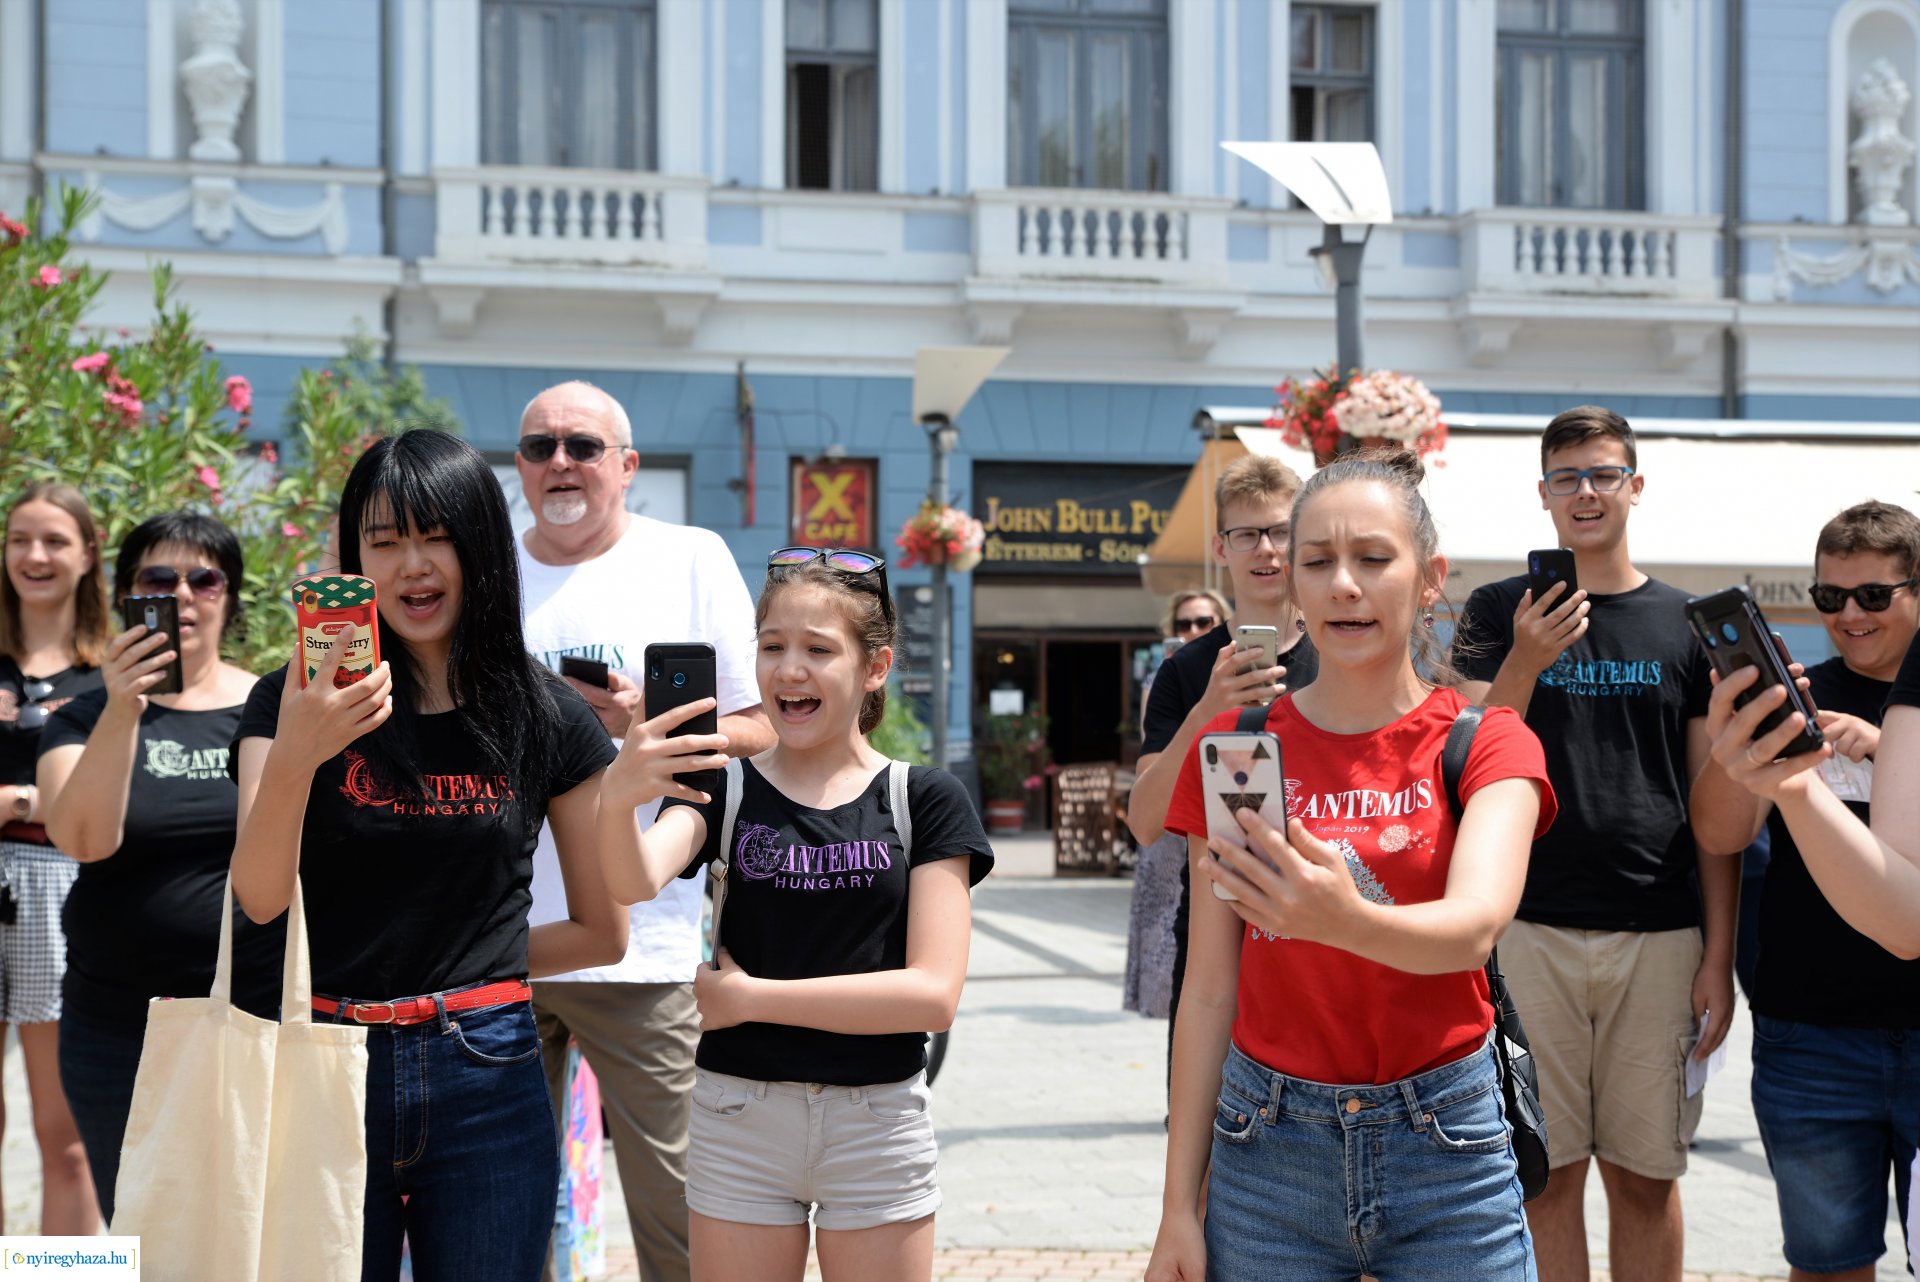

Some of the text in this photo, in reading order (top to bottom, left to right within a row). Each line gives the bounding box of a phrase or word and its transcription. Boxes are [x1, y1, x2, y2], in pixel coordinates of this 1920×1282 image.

[807, 472, 856, 521] X
[985, 497, 1053, 533] JOHN
[1056, 499, 1128, 533] BULL
[305, 636, 370, 650] Straerry
[1566, 683, 1645, 696] HUNGARY
[393, 802, 500, 816] HUNGARY
[1343, 825, 1370, 835] 2019
[774, 874, 876, 890] HUNGARY
